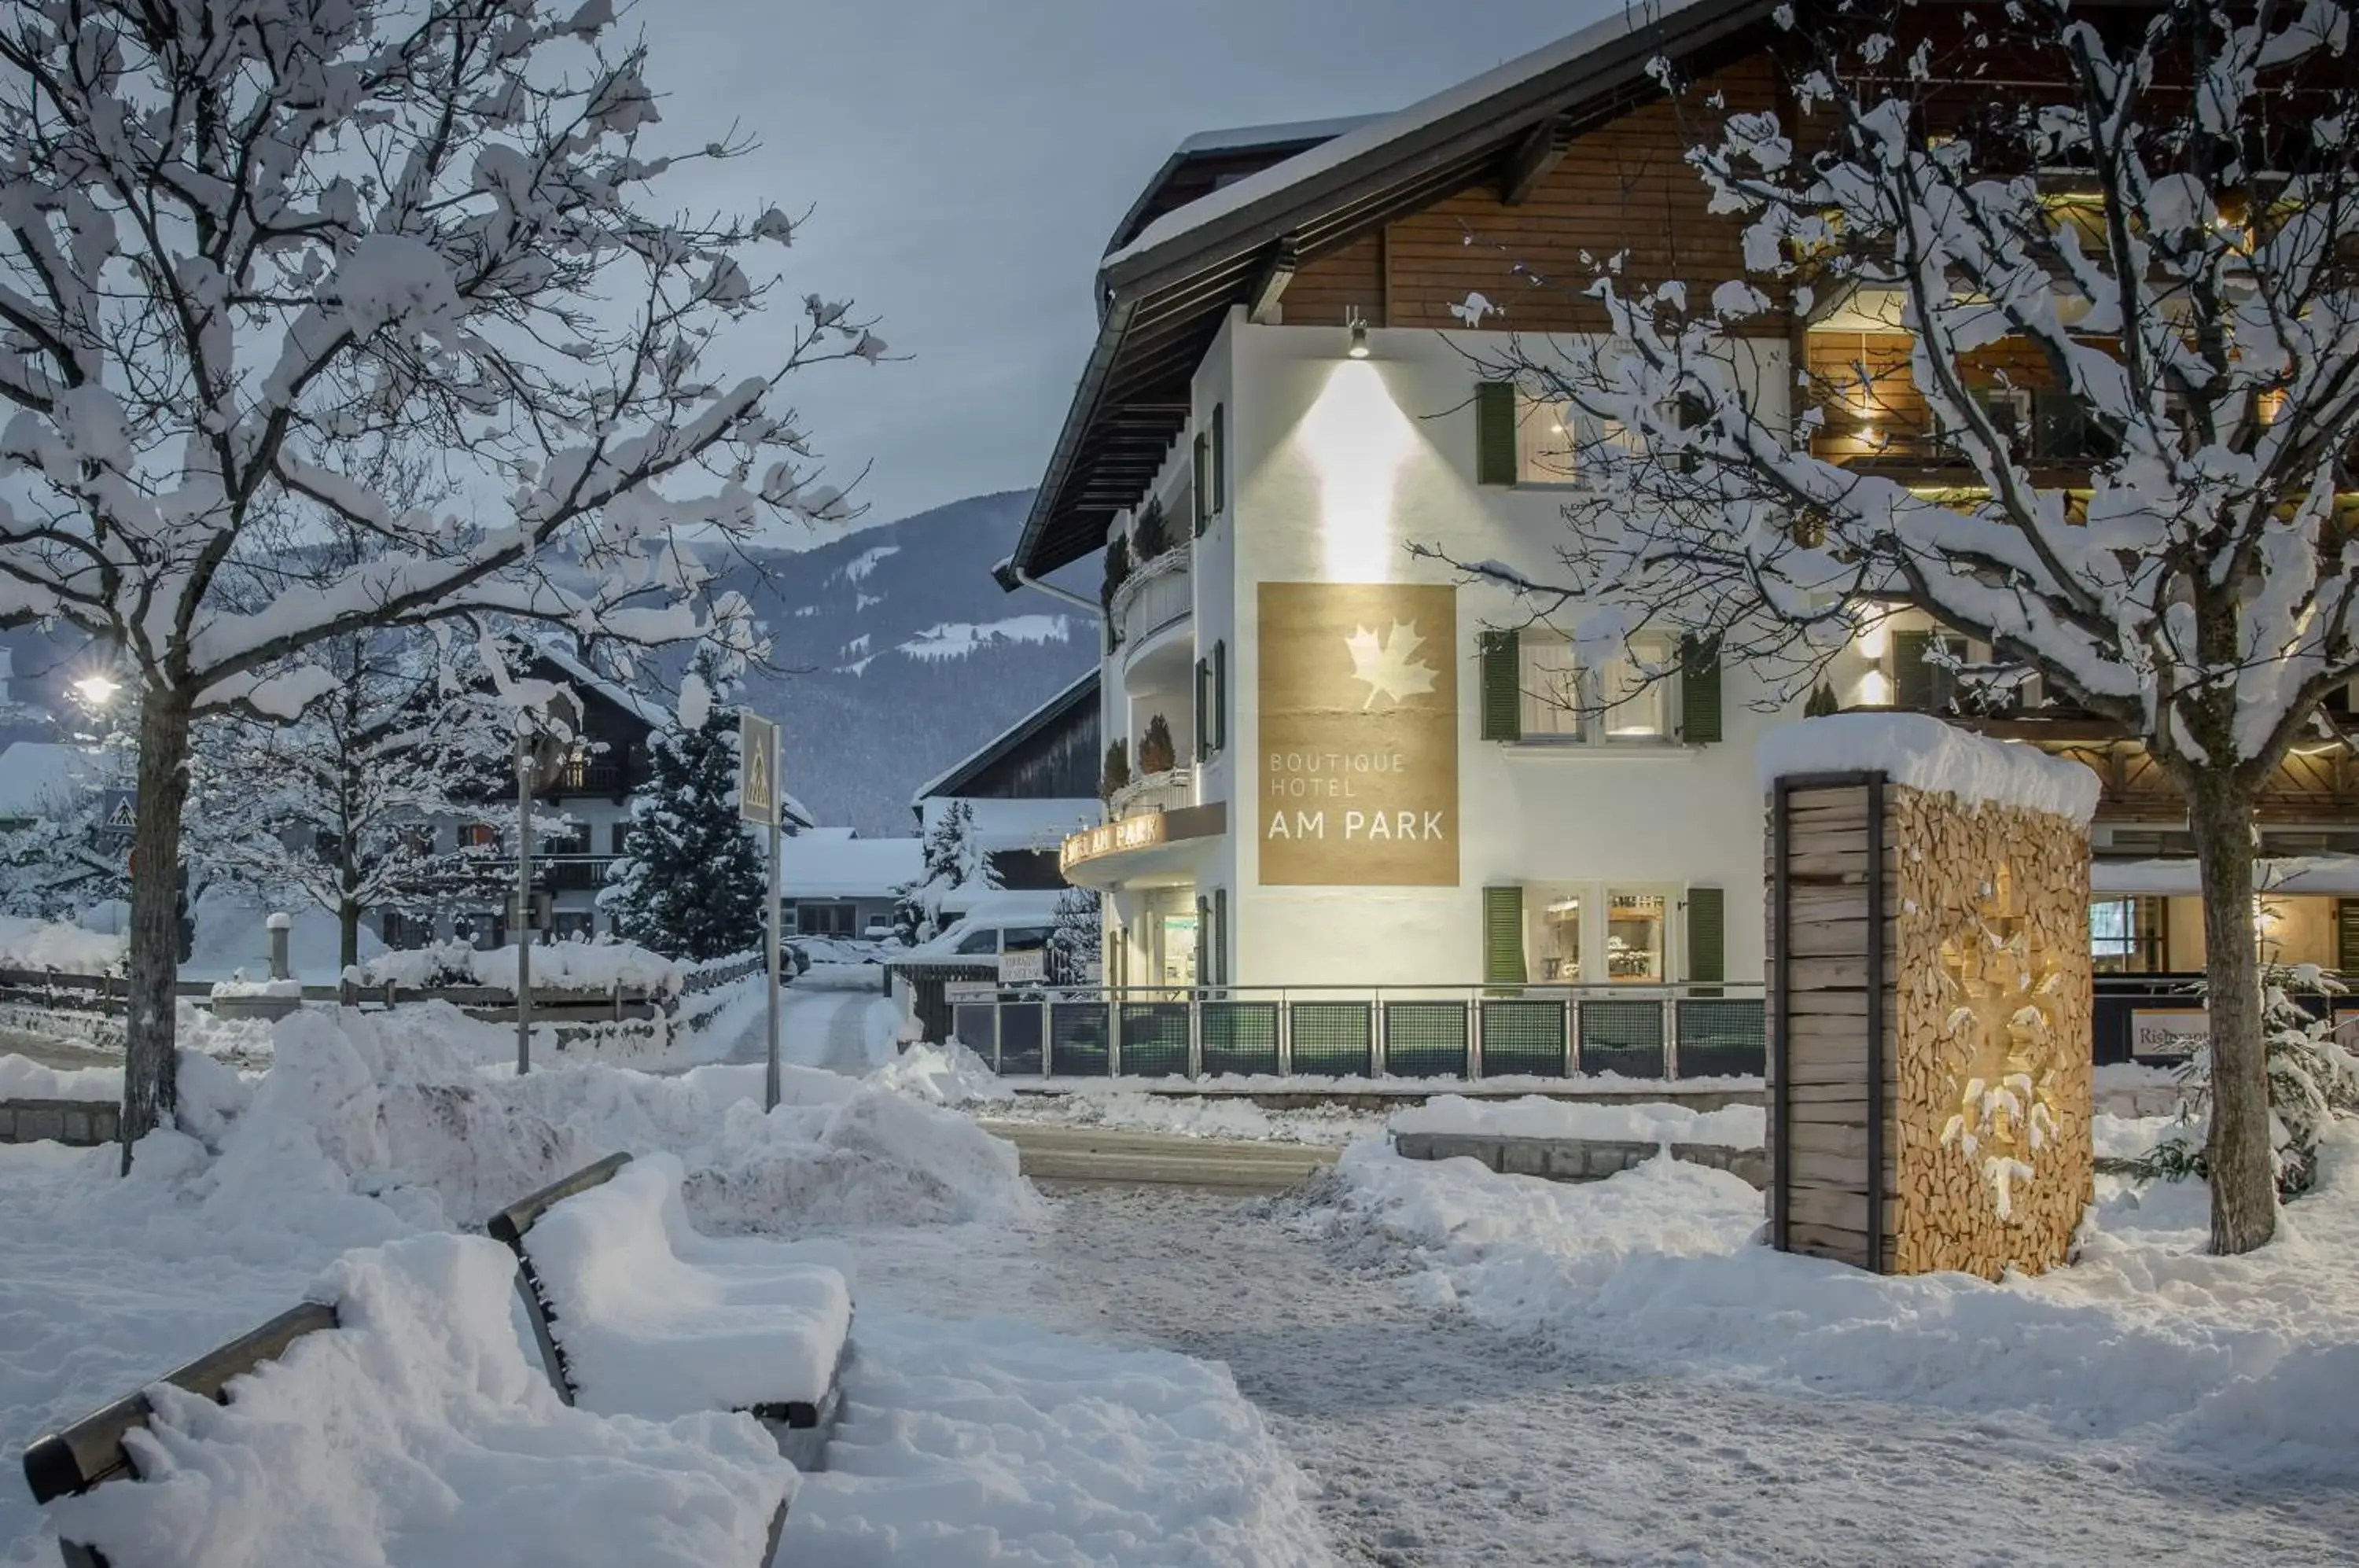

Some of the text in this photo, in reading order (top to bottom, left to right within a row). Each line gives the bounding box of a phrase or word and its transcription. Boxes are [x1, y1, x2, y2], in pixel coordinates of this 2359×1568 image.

[1270, 753, 1404, 772] BOUTIQUE
[1272, 778, 1356, 797] HOTEL
[1268, 810, 1443, 840] AM PARK
